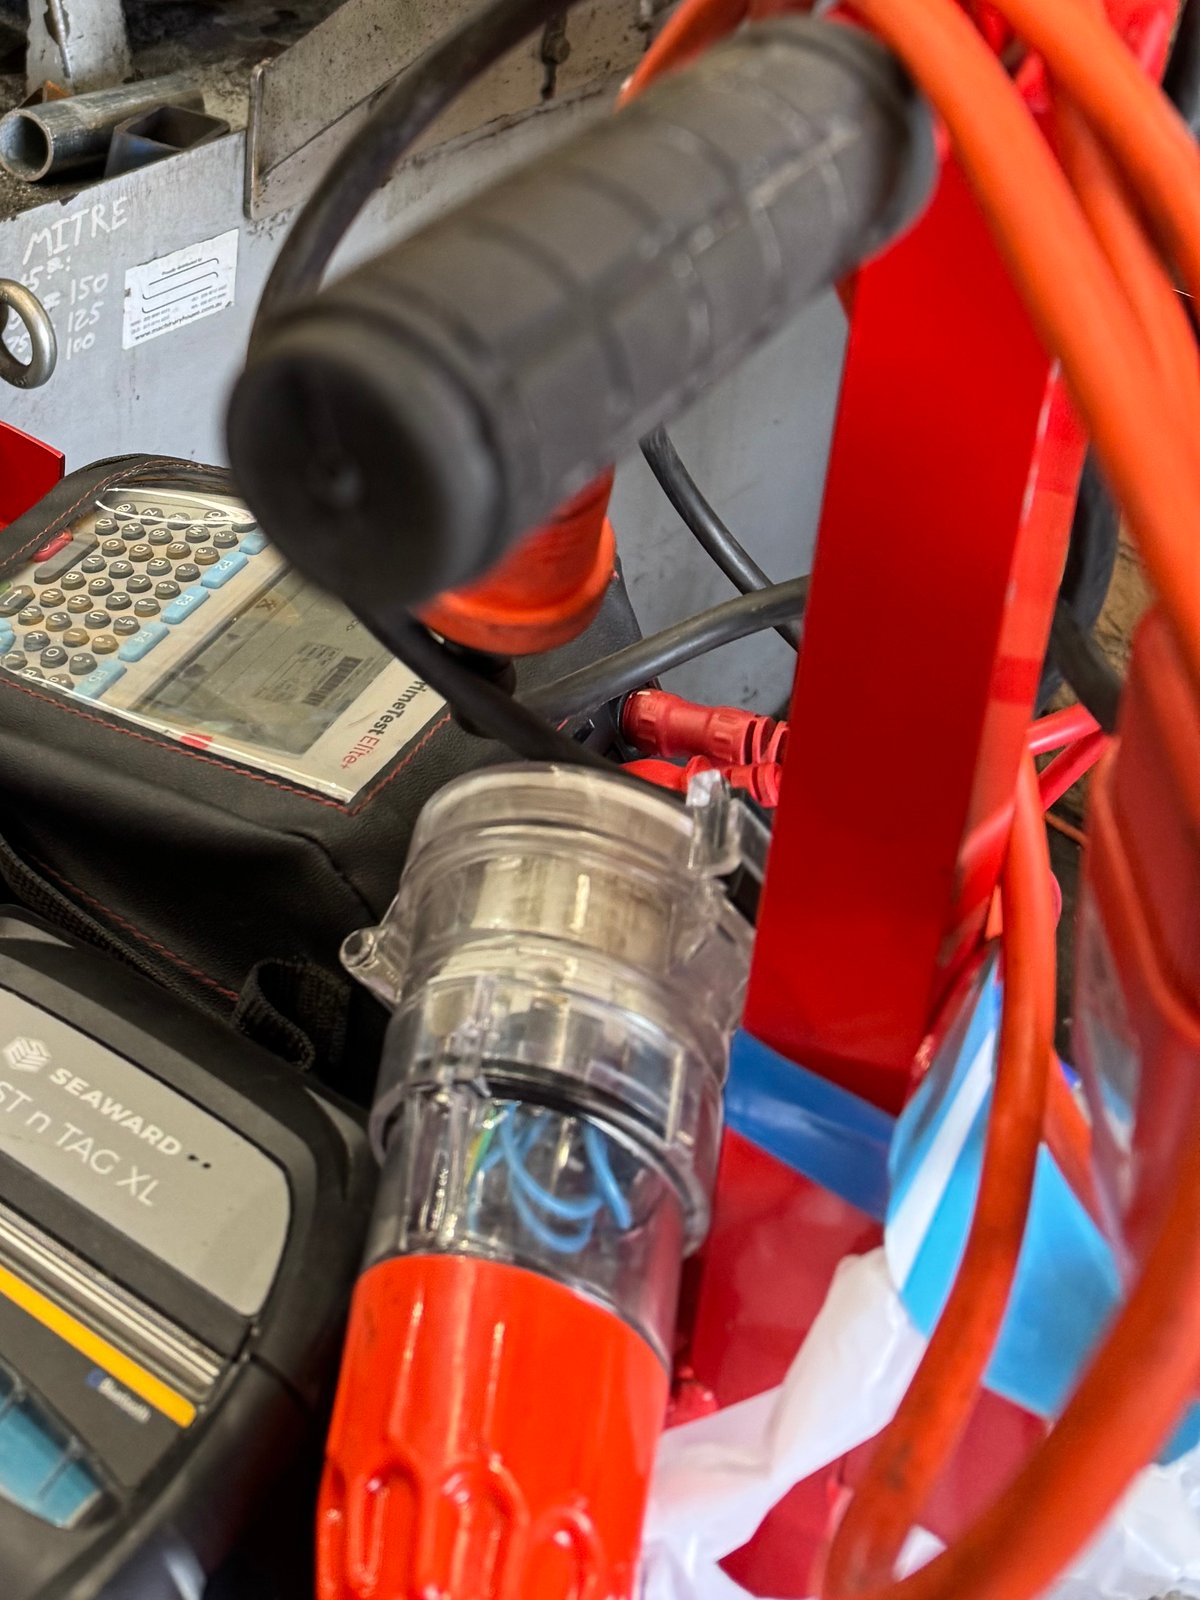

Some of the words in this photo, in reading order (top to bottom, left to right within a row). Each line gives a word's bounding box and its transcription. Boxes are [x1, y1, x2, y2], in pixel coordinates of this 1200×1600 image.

[22, 197, 128, 266] MITRE
[67, 301, 105, 333] 125
[70, 273, 109, 305] 150
[367, 680, 427, 736] rimeTest
[49, 1067, 183, 1156] SEAWARD
[25, 1110, 52, 1134] n
[56, 1122, 121, 1175] TAG
[115, 1165, 160, 1207] XL
